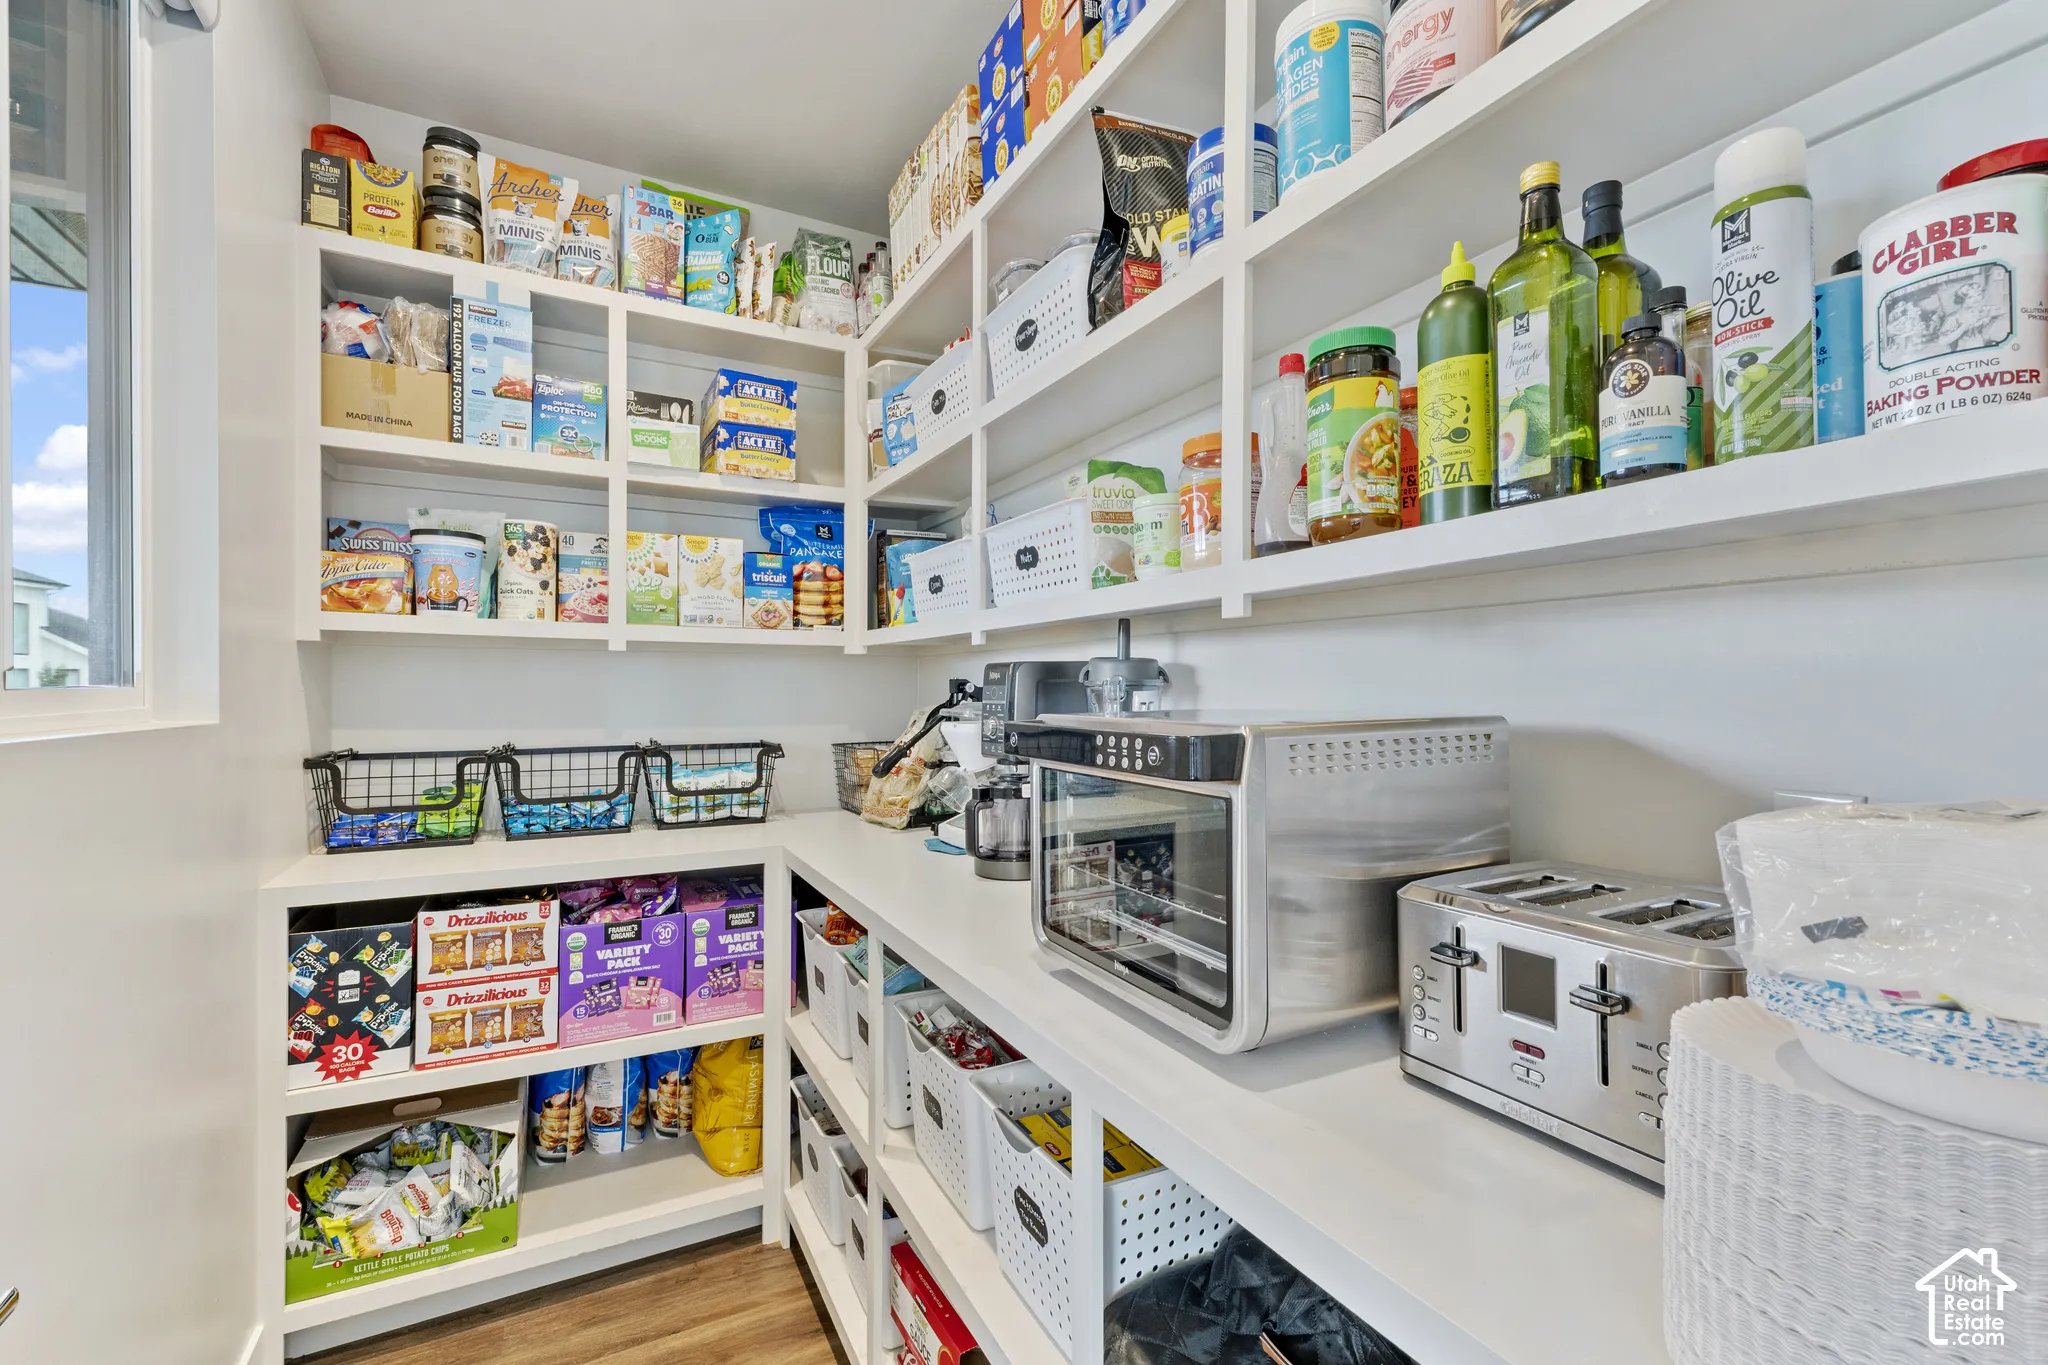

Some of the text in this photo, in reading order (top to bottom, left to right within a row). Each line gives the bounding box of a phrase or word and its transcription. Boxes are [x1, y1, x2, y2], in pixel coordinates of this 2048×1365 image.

[1386, 7, 1454, 70] energy
[310, 162, 340, 174] RIGATONI
[488, 172, 564, 201] Archer
[367, 206, 398, 218] Barilla
[379, 225, 386, 234] 4
[499, 224, 545, 242] MINIS
[1873, 211, 2018, 275] CLABBER
[560, 245, 602, 260] MINIS
[1735, 253, 1758, 264] VIRGIN
[1897, 238, 1980, 275] GIRL
[807, 256, 849, 279] FLOUR
[1712, 270, 1780, 306] Olive
[470, 306, 497, 315] KIRKLAND
[1717, 290, 1765, 328] Oil
[468, 314, 512, 328] FREEZER
[1717, 320, 1764, 343] NON-STICK
[1718, 333, 1761, 349] COOKING SPRAY
[453, 303, 462, 439] 192 GALLON PLUS FOOD BAGS
[1435, 362, 1453, 372] Sizzle
[1634, 364, 1648, 376] STAR
[1889, 357, 2000, 388] DOUBLE ACTING
[1441, 371, 1458, 383] Olive
[1459, 369, 1470, 379] Oil
[537, 382, 564, 396] Ziploc
[584, 385, 602, 394] 580
[742, 383, 778, 398] ACT II
[1867, 369, 2040, 418] BAKING POWDER
[541, 404, 597, 418] PROTECTION
[553, 401, 586, 409] ON-THE-GO
[627, 401, 658, 414] Reflections
[740, 401, 780, 413] Butter Lovers
[1307, 402, 1332, 418] Knorr
[1872, 417, 1883, 430] NET
[1885, 414, 1898, 426] WT
[1901, 409, 1914, 419] 22
[1917, 404, 1931, 415] OZ
[1951, 398, 1967, 409] LB
[1971, 396, 1979, 406] 6
[1982, 393, 2003, 404] OZ)
[2006, 391, 2031, 402] 624g
[346, 411, 413, 427] MADE IN CHINA
[1623, 405, 1671, 421] VANILLA
[1745, 409, 1772, 419] FLAVORS
[562, 428, 577, 438] 3X
[634, 435, 668, 445] SPOONS
[742, 435, 778, 450] ACT II
[740, 453, 780, 463] Butter Lovers
[1440, 450, 1462, 458] COOKING
[1406, 474, 1418, 487] &
[1093, 484, 1136, 498] truvia
[1092, 500, 1114, 509] SWEET
[1092, 512, 1114, 520] BROWN
[506, 524, 522, 533] 365
[341, 538, 380, 550] SWISS
[562, 535, 574, 546] 40
[790, 547, 844, 559] PANCAKE
[1020, 553, 1032, 564] Nuts
[321, 559, 388, 578] Apple Cider
[752, 571, 787, 583] triscuit
[448, 911, 528, 928] Drizzilicious
[729, 912, 755, 920] FRANKIE'S
[731, 918, 753, 926] ORGANIC
[608, 924, 638, 934] FRANKIE'S
[611, 931, 636, 940] ORGANIC
[658, 928, 672, 939] 30
[718, 930, 764, 944] VARIETY
[596, 944, 652, 960] VARIETY
[728, 941, 757, 953] PACK
[296, 950, 326, 973] popchips
[371, 941, 400, 969] popchips
[607, 956, 640, 970] PACK
[464, 976, 491, 984] REIMAGINED
[447, 987, 528, 1007] Drizzilicious
[1427, 995, 1442, 1003] DEFROST
[370, 1002, 398, 1029] popchips
[295, 1013, 325, 1035] popchips
[332, 1043, 363, 1063] 30
[1636, 1042, 1653, 1051] SINGLE
[340, 1060, 365, 1068] CALORIE
[1519, 1056, 1537, 1066] MEMORY
[1632, 1064, 1654, 1076] DEFROST
[746, 1056, 758, 1109] JASMINE
[1516, 1076, 1541, 1089] BREAD TYPE
[1635, 1090, 1654, 1101] CANCEL
[1500, 1100, 1561, 1136] Cuisinart
[407, 1184, 430, 1212] BOULDER
[380, 1209, 403, 1245] BOULDER
[354, 1261, 379, 1273] KETTLE
[382, 1256, 403, 1266] STYLE
[405, 1248, 429, 1261] POTATO
[431, 1244, 449, 1254] CHIPS
[910, 1323, 931, 1365] SAUCE
